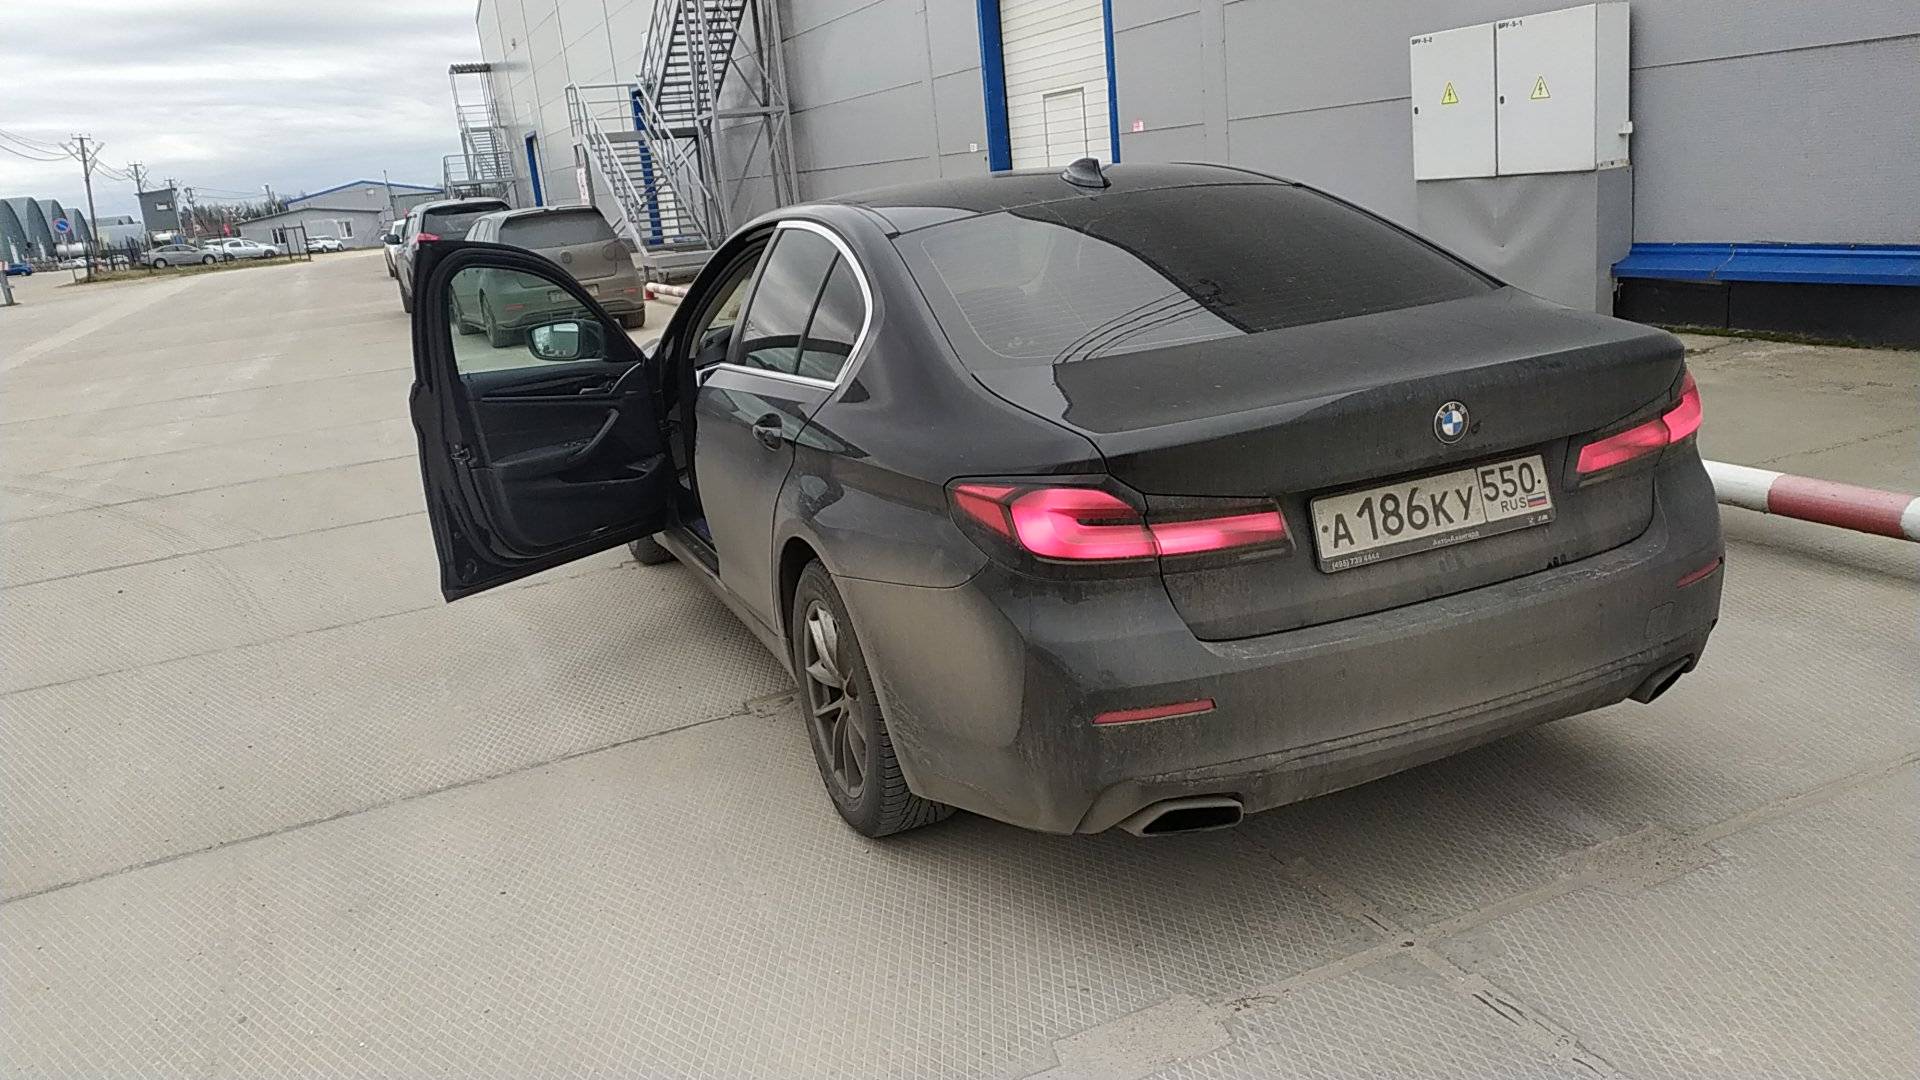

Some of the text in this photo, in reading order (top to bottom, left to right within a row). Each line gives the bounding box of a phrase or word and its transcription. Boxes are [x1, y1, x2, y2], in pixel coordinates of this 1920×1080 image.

[1438, 403, 1466, 418] BMW
[1480, 462, 1535, 501] 550
[1500, 497, 1527, 512] RUS
